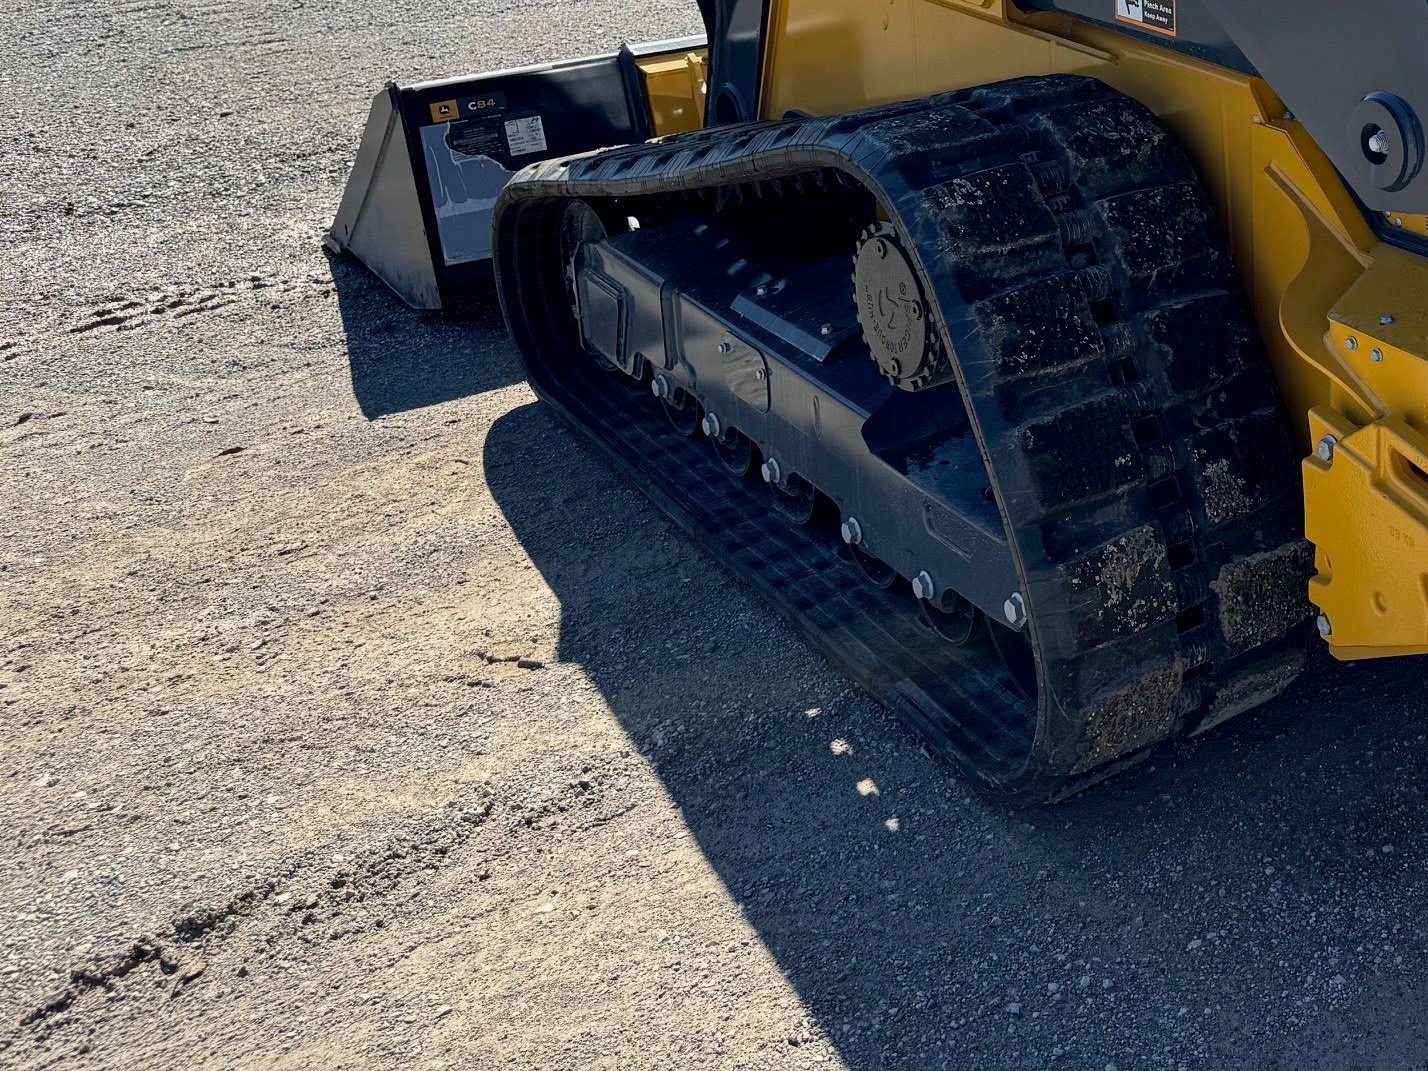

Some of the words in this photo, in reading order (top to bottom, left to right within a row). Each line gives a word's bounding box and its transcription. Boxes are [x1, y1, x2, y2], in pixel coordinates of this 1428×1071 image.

[1144, 0, 1158, 10] Pinch
[1159, 4, 1171, 14] Area
[468, 98, 496, 110] C84
